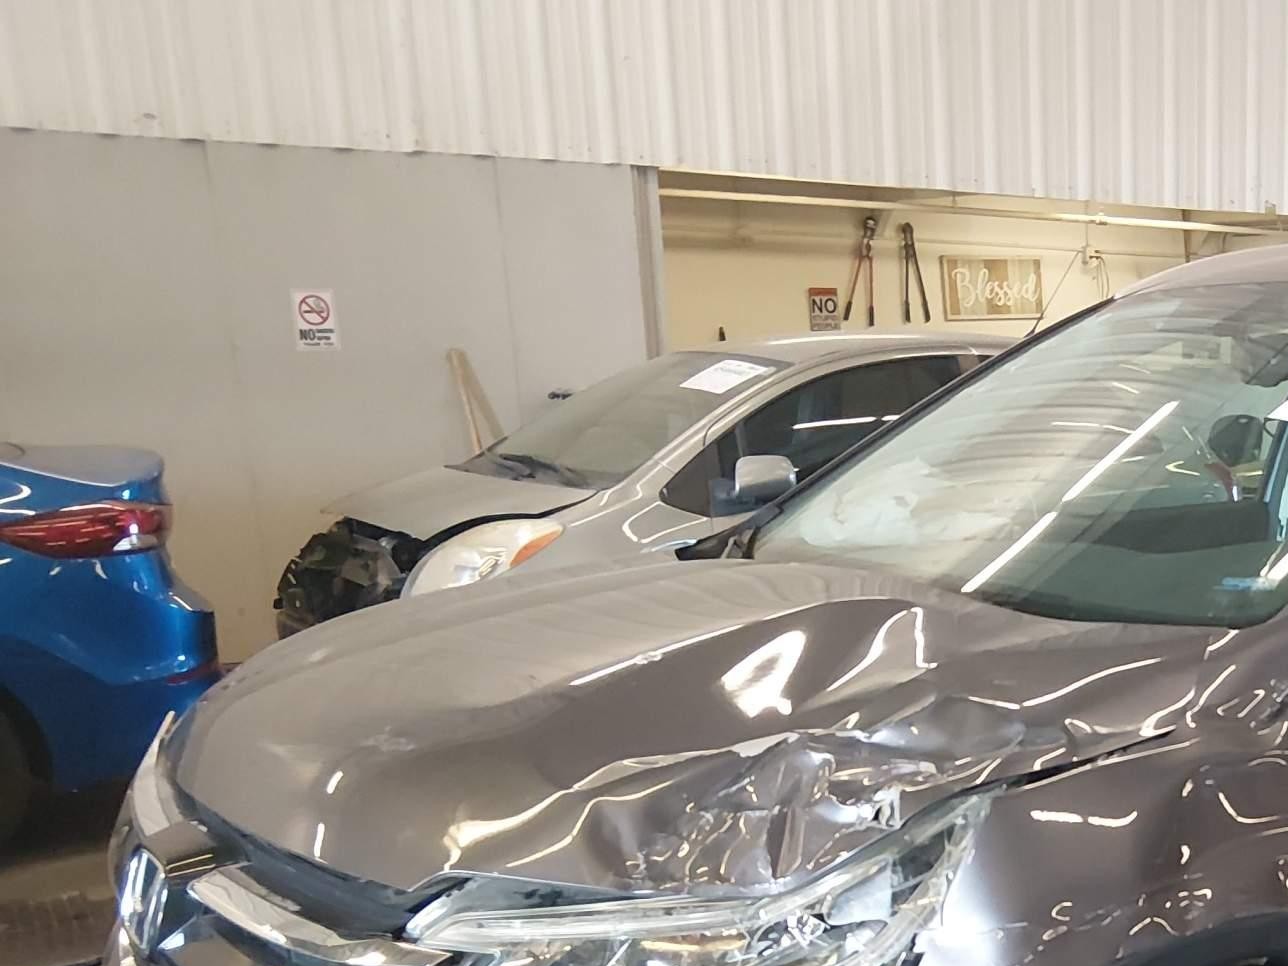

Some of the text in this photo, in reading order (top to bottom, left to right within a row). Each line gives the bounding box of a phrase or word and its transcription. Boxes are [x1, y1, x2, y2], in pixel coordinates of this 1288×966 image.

[951, 268, 1040, 307] Blessed
[811, 298, 837, 314] NO
[299, 329, 316, 341] NO
